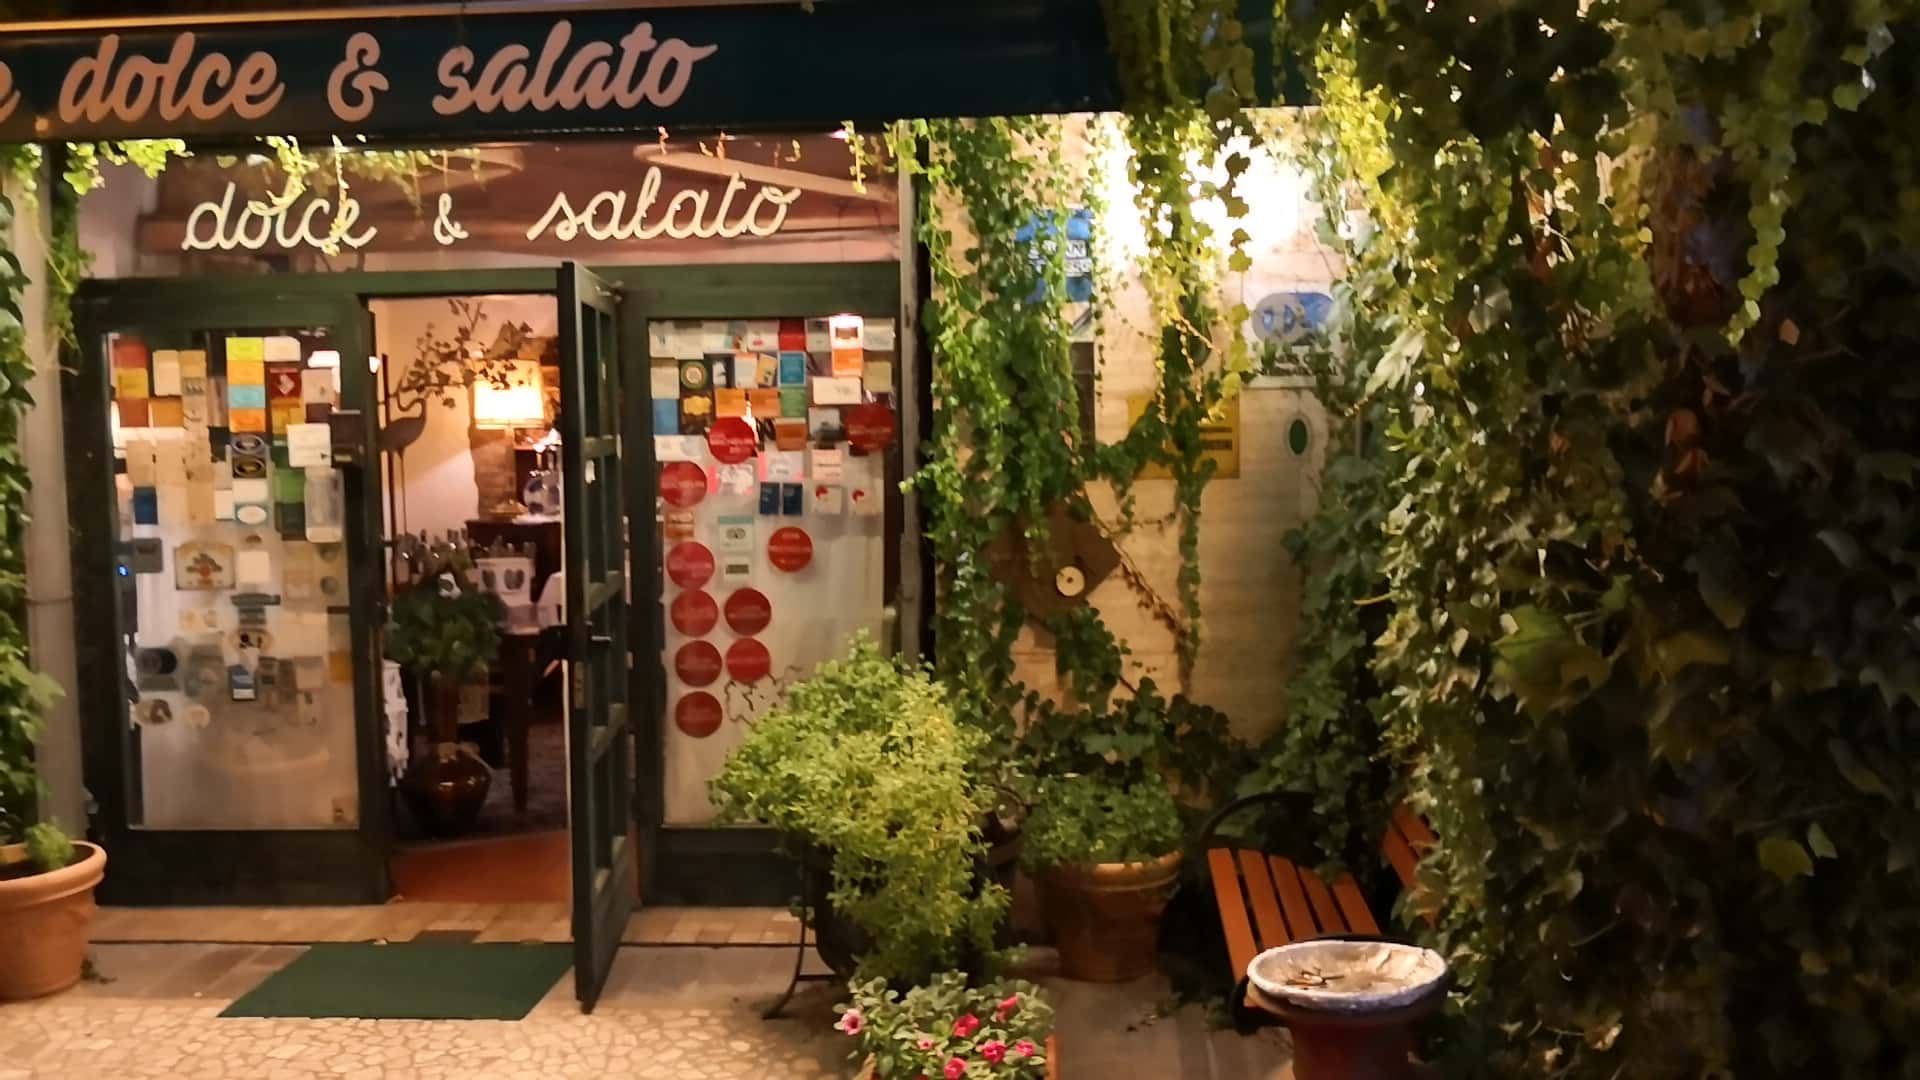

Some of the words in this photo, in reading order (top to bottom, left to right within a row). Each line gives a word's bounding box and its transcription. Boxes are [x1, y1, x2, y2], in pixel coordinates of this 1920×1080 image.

[58, 31, 286, 123] dolce
[327, 31, 390, 123] &
[431, 18, 719, 116] salato
[181, 180, 378, 252] dolce
[432, 192, 470, 246] &
[525, 165, 802, 242] salato
